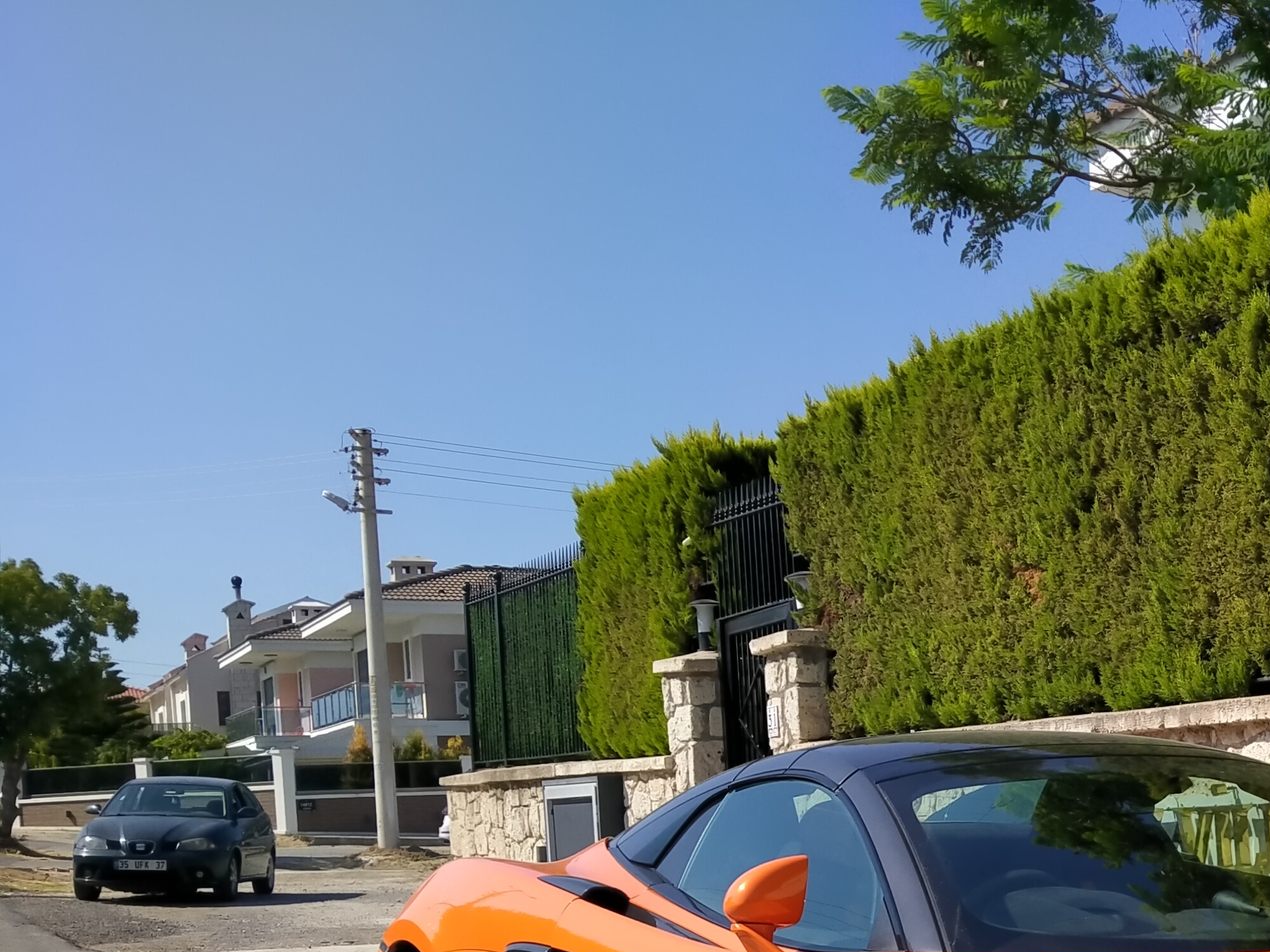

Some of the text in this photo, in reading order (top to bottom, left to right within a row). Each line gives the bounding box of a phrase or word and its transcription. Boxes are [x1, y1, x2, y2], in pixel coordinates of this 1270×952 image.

[119, 860, 165, 869] 35 UFK 37
